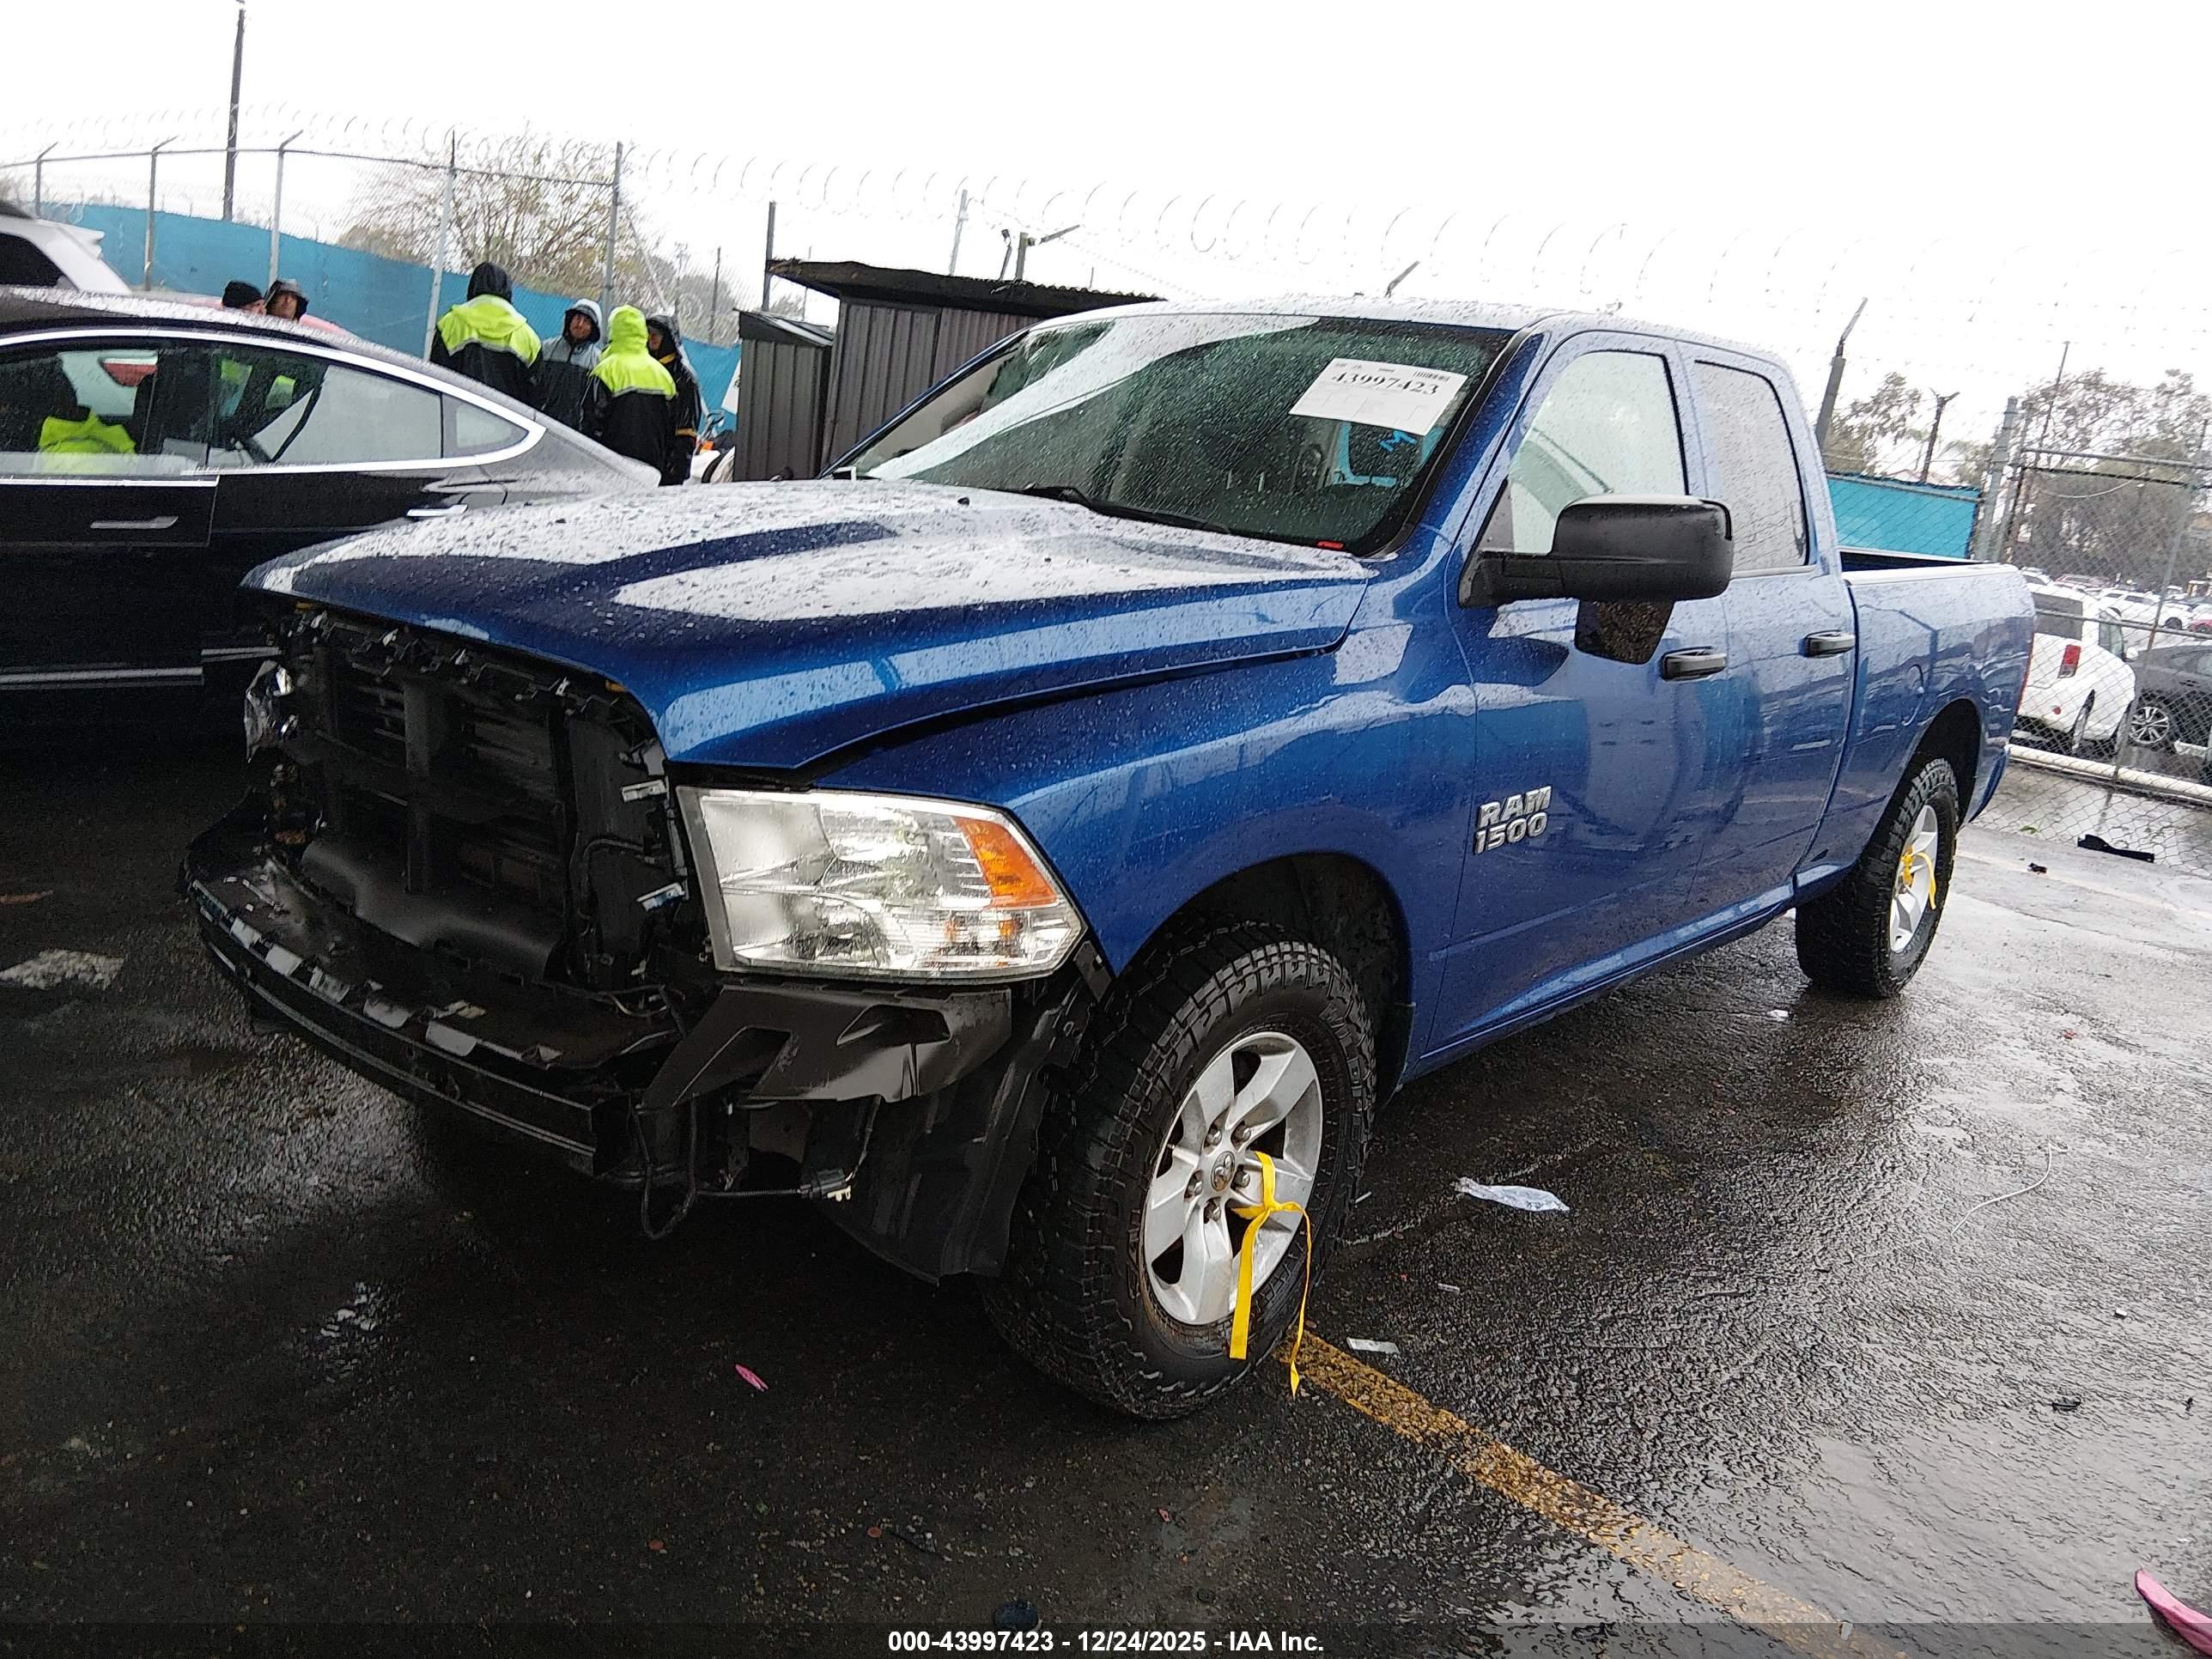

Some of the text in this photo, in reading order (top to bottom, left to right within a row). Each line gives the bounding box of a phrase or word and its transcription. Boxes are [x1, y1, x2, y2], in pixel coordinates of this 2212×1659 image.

[1332, 371, 1439, 396] 43997423
[1476, 786, 1552, 829] RAM
[1474, 811, 1547, 854] 1500
